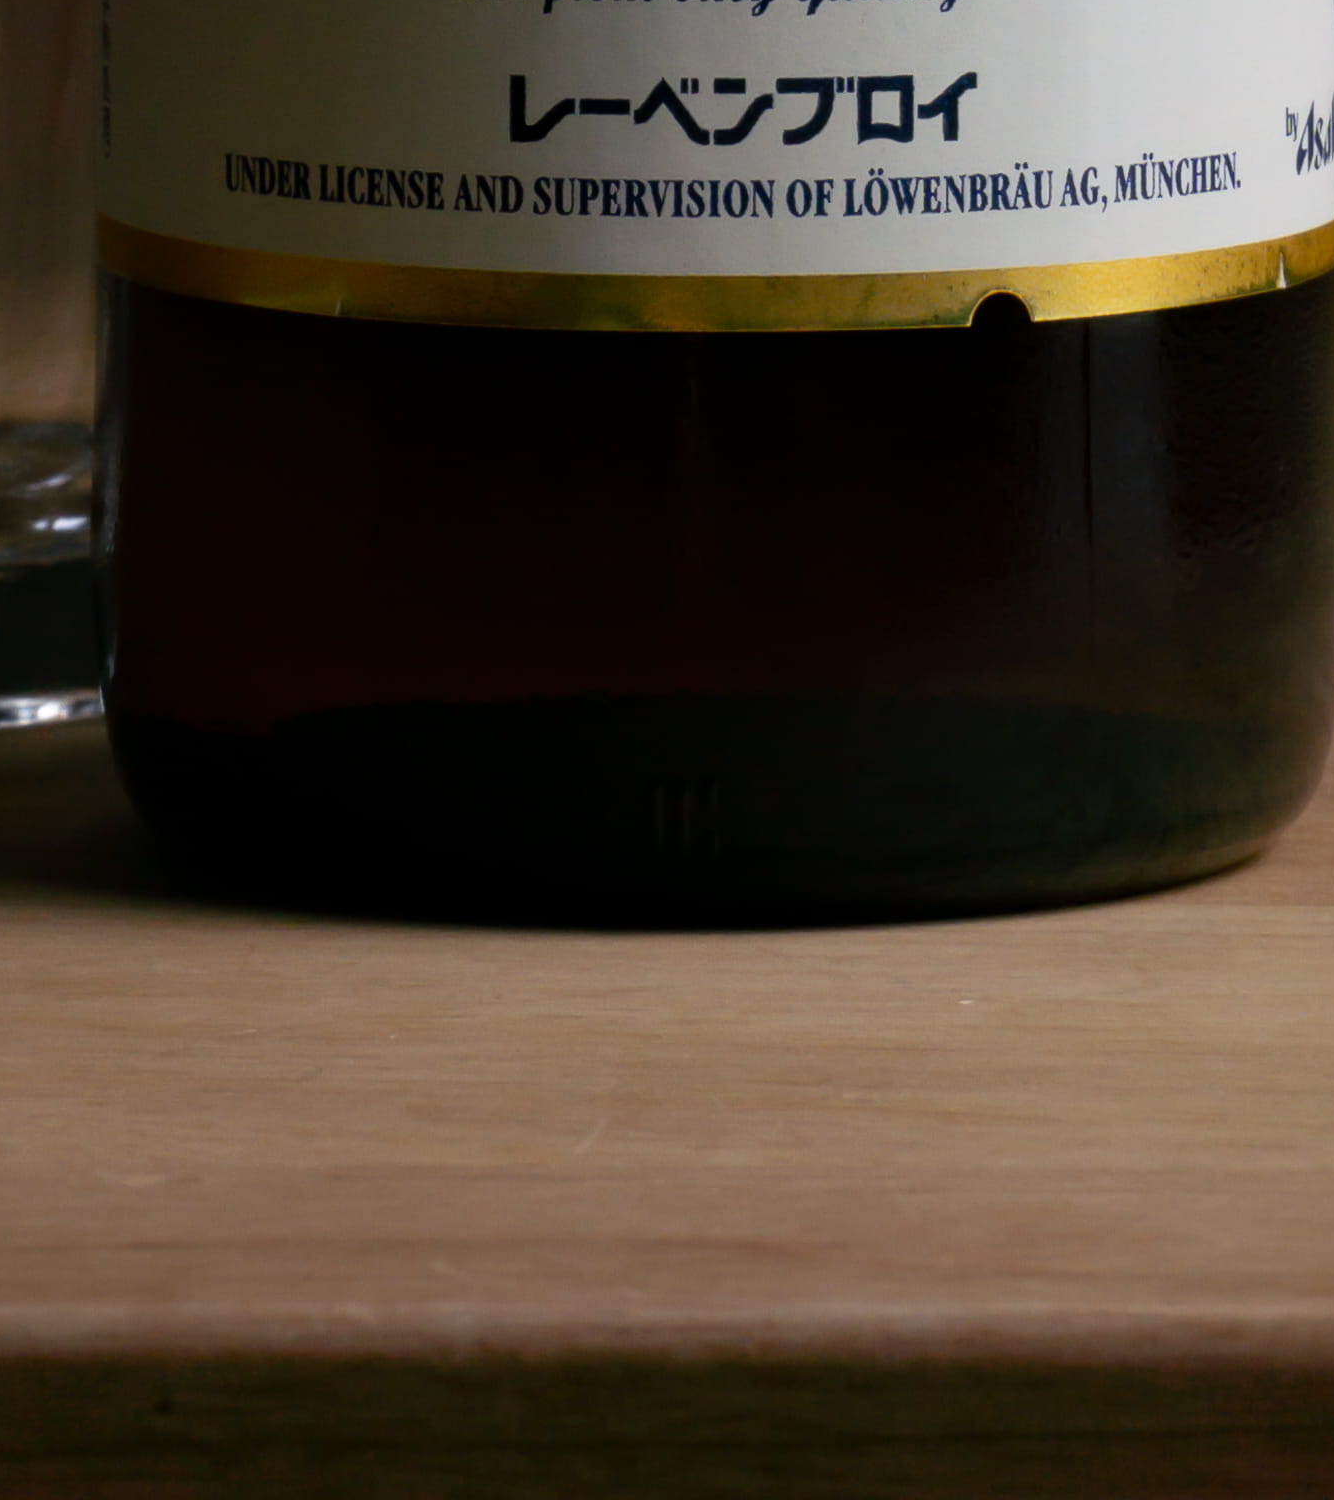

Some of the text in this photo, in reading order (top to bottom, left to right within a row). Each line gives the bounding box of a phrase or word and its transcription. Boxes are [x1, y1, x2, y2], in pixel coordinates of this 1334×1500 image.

[509, 72, 977, 146] レーベンブロイ
[1285, 106, 1299, 142] by
[224, 153, 1243, 218] UNDER LICENSE AND SUPERVISION OF LÖWENBRÄU AG, MÜNCHEN.
